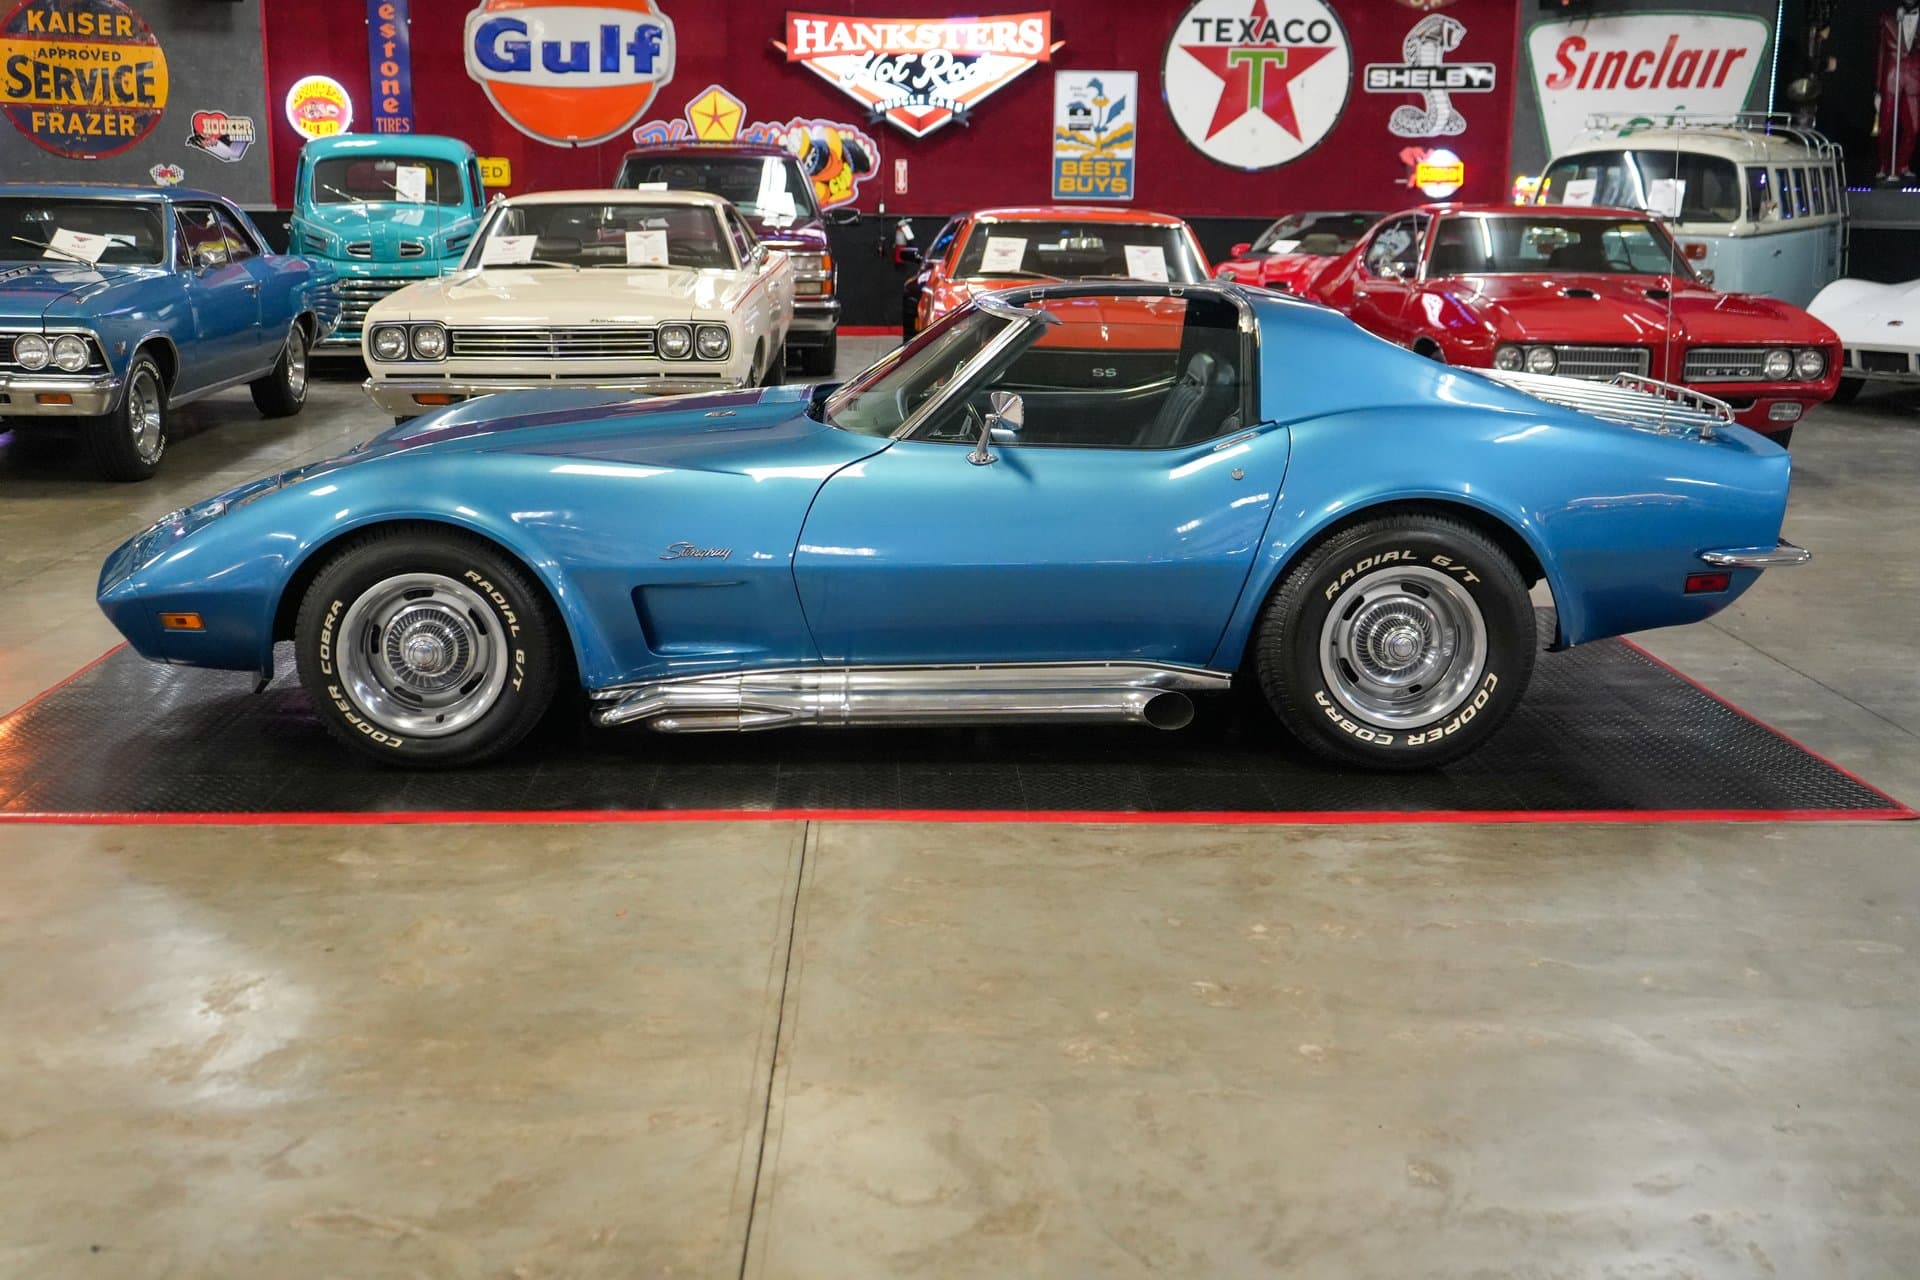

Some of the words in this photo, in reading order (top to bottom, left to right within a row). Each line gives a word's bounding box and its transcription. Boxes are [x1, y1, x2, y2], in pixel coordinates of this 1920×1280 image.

[27, 10, 133, 37] KAISER
[793, 18, 1045, 54] HANKSTERS
[1192, 18, 1331, 43] TEXACO
[38, 48, 121, 62] APPROVED
[474, 17, 663, 73] Gulf
[1545, 34, 1747, 91] Sinclair
[7, 54, 156, 103] SERVICE
[1228, 48, 1288, 110] T
[1369, 67, 1489, 88] SHELBY
[31, 111, 136, 137] FRAZER
[202, 118, 252, 136] HOOKER
[376, 117, 410, 132] TIRES
[1061, 160, 1126, 176] BEST
[1058, 177, 1127, 192] BUYS
[1092, 367, 1117, 378] SS
[1706, 368, 1751, 377] GTO
[658, 541, 732, 560] Stingray
[1324, 550, 1418, 600] RADIAL
[1431, 553, 1481, 585] G/T
[320, 600, 344, 675] COBRA
[464, 570, 521, 638] RADIAL
[512, 649, 526, 692] G/T
[327, 685, 404, 749] COOPER
[1314, 690, 1394, 746] COBRA
[1407, 672, 1499, 747] COOPER
